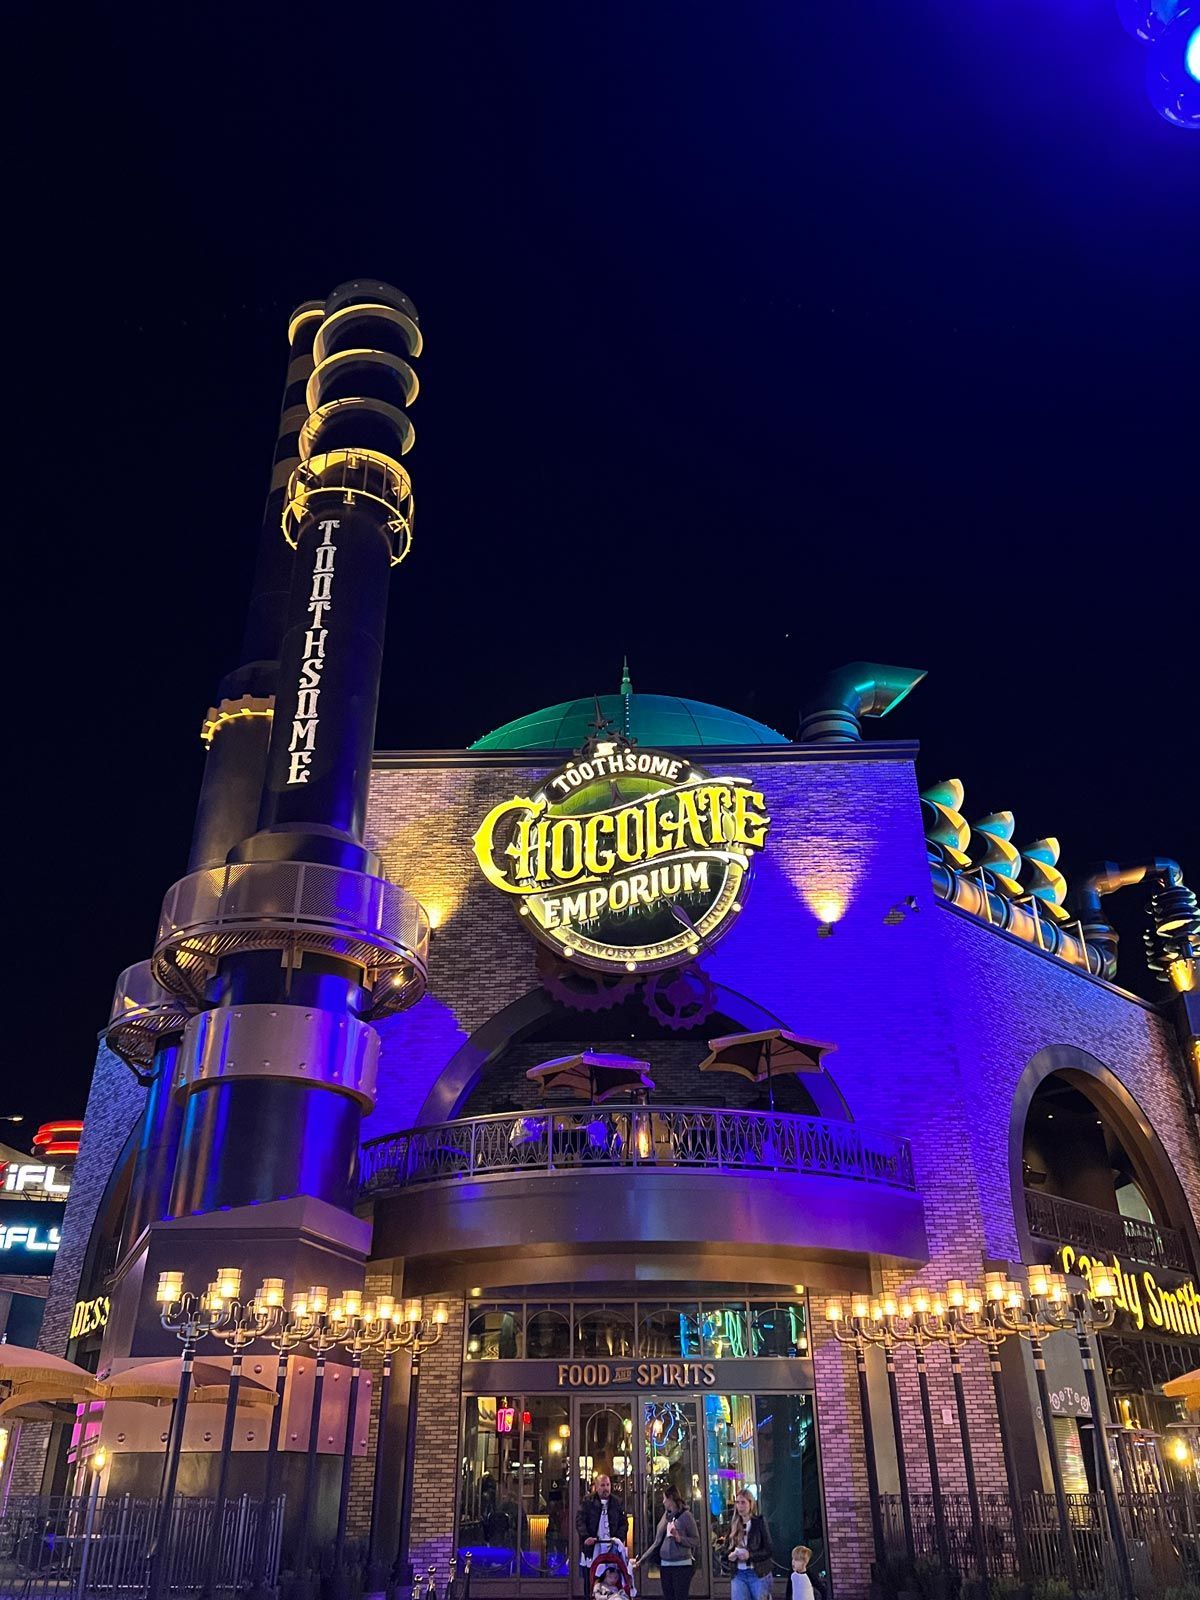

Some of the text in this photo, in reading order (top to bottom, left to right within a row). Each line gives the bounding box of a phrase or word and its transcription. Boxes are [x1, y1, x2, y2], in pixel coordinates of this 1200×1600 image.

[286, 519, 340, 785] TOOTHSOME
[552, 753, 683, 793] TOOTHSOME
[471, 785, 771, 894] CHOCOLATE
[540, 861, 711, 930] EMPORIUM
[578, 937, 638, 959] SAVORY
[643, 930, 694, 959] FEAST
[697, 872, 740, 936] KITCHEN
[5, 1164, 71, 1192] iFL
[558, 1364, 610, 1387] FOOD
[636, 1363, 716, 1388] SPIRITS
